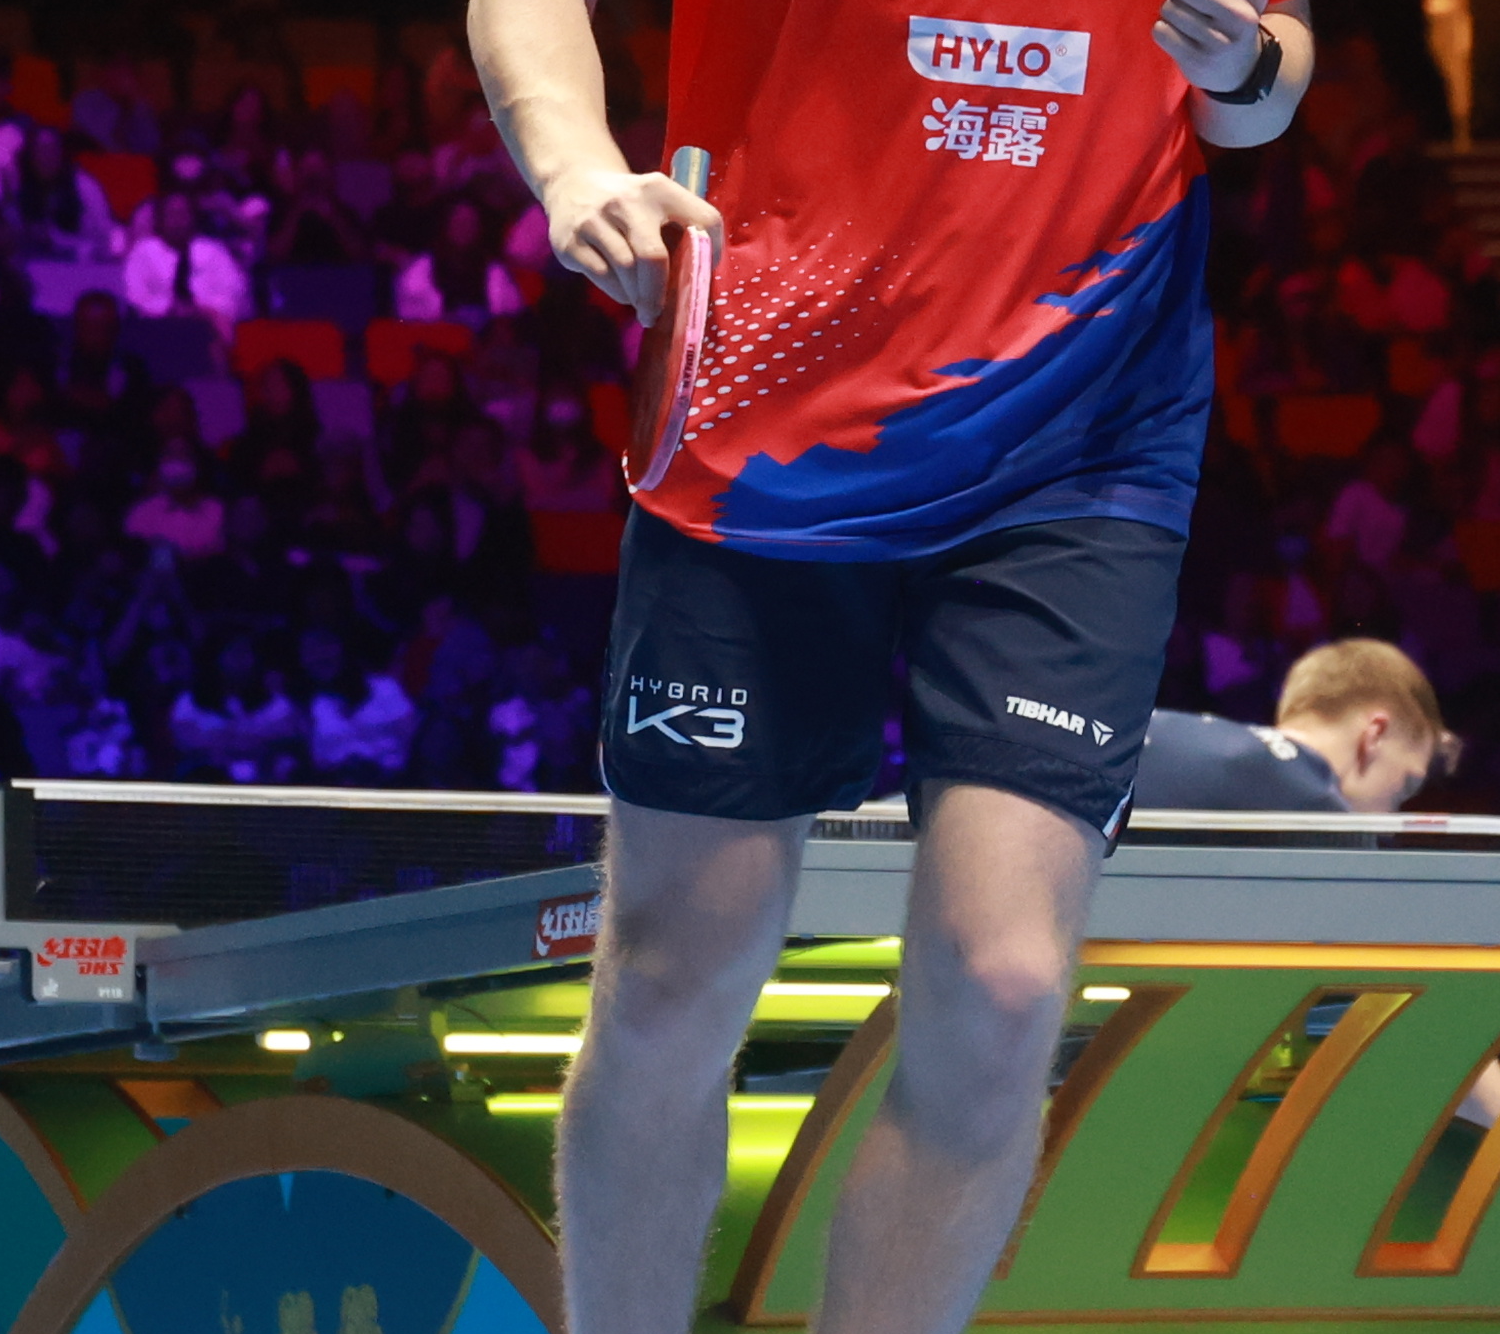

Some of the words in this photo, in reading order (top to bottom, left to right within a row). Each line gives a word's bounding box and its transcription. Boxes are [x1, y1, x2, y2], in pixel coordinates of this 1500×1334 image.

[922, 97, 1048, 167] 海露
[630, 675, 748, 705] HYBRID
[627, 695, 746, 749] K3
[1006, 695, 1086, 735] TIBHAR
